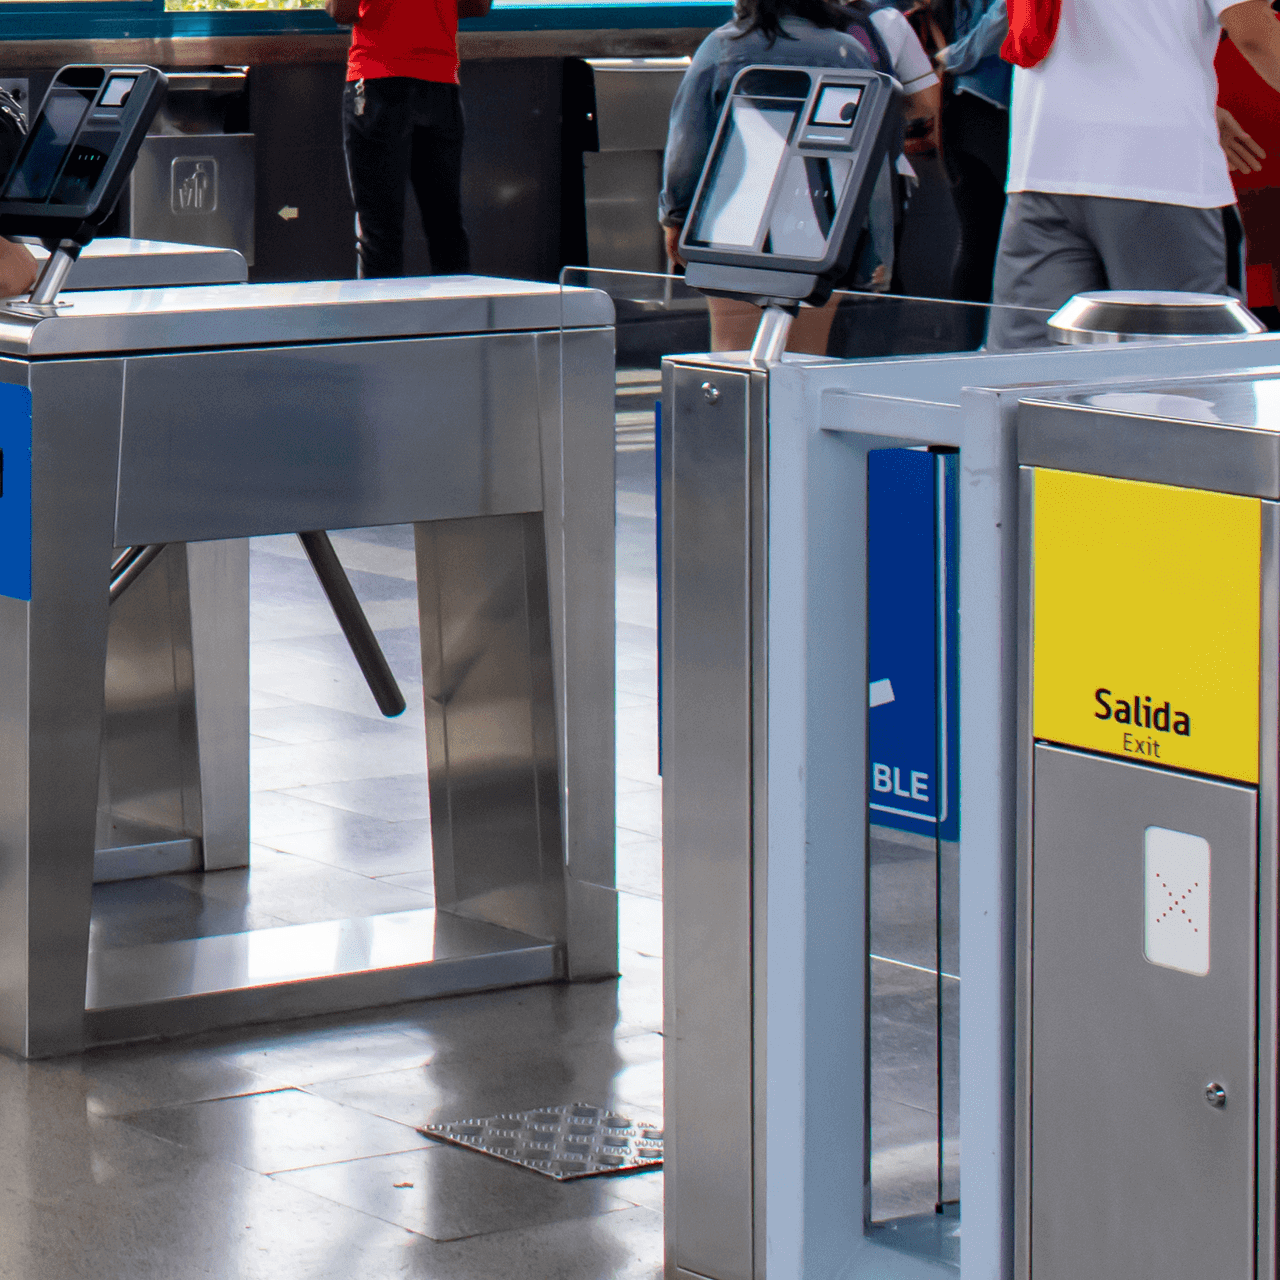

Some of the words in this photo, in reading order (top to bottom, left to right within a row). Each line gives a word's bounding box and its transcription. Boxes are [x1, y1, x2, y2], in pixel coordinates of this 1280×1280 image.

[1094, 688, 1192, 737] Salida
[1123, 733, 1161, 758] Exit
[873, 762, 930, 802] BLE
